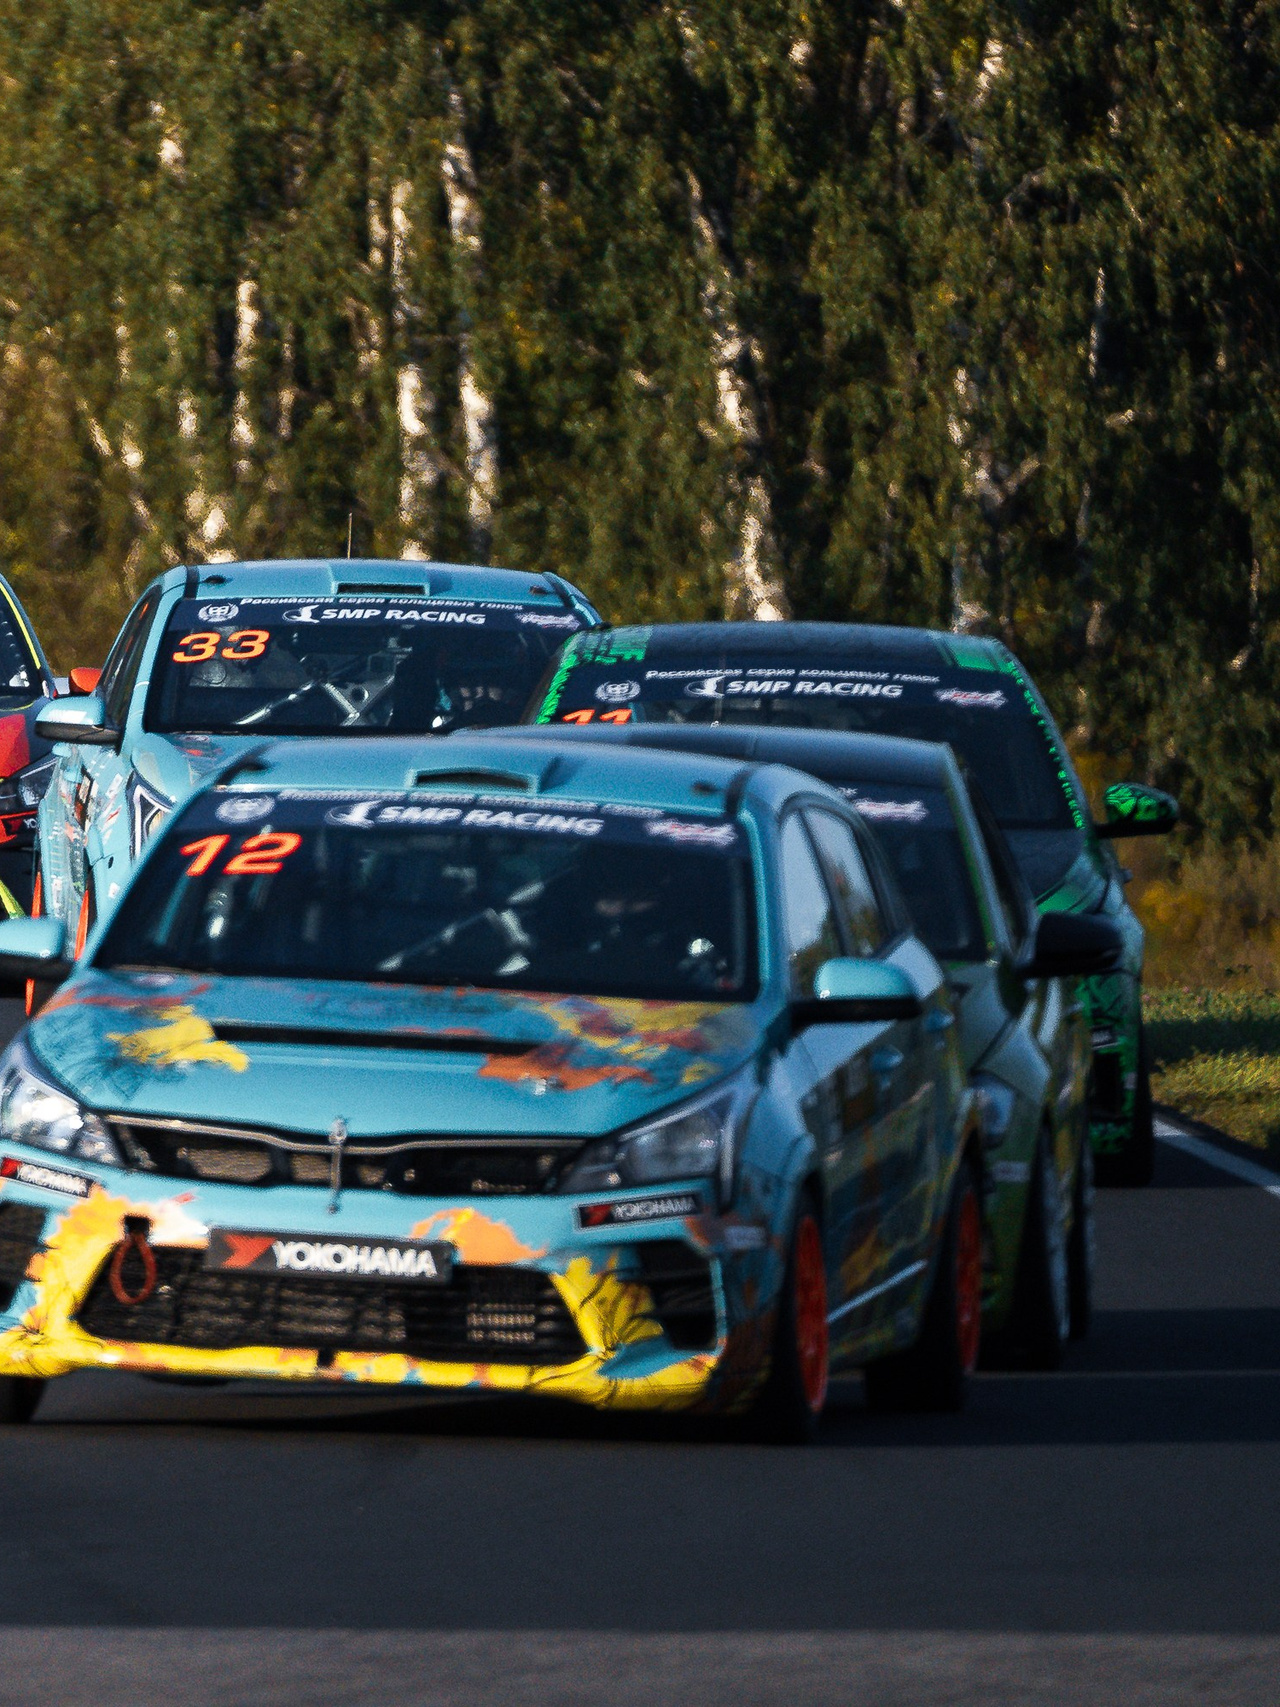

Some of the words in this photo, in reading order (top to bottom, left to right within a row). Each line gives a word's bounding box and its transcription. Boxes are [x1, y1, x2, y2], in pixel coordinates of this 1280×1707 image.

[321, 608, 381, 620] SMP
[385, 609, 486, 625] RACING
[172, 629, 270, 663] 33
[726, 680, 791, 693] SMP
[793, 680, 903, 698] RACING
[461, 807, 605, 836] RACING
[180, 832, 303, 877] 12
[271, 1241, 437, 1278] YOKOHAMA
